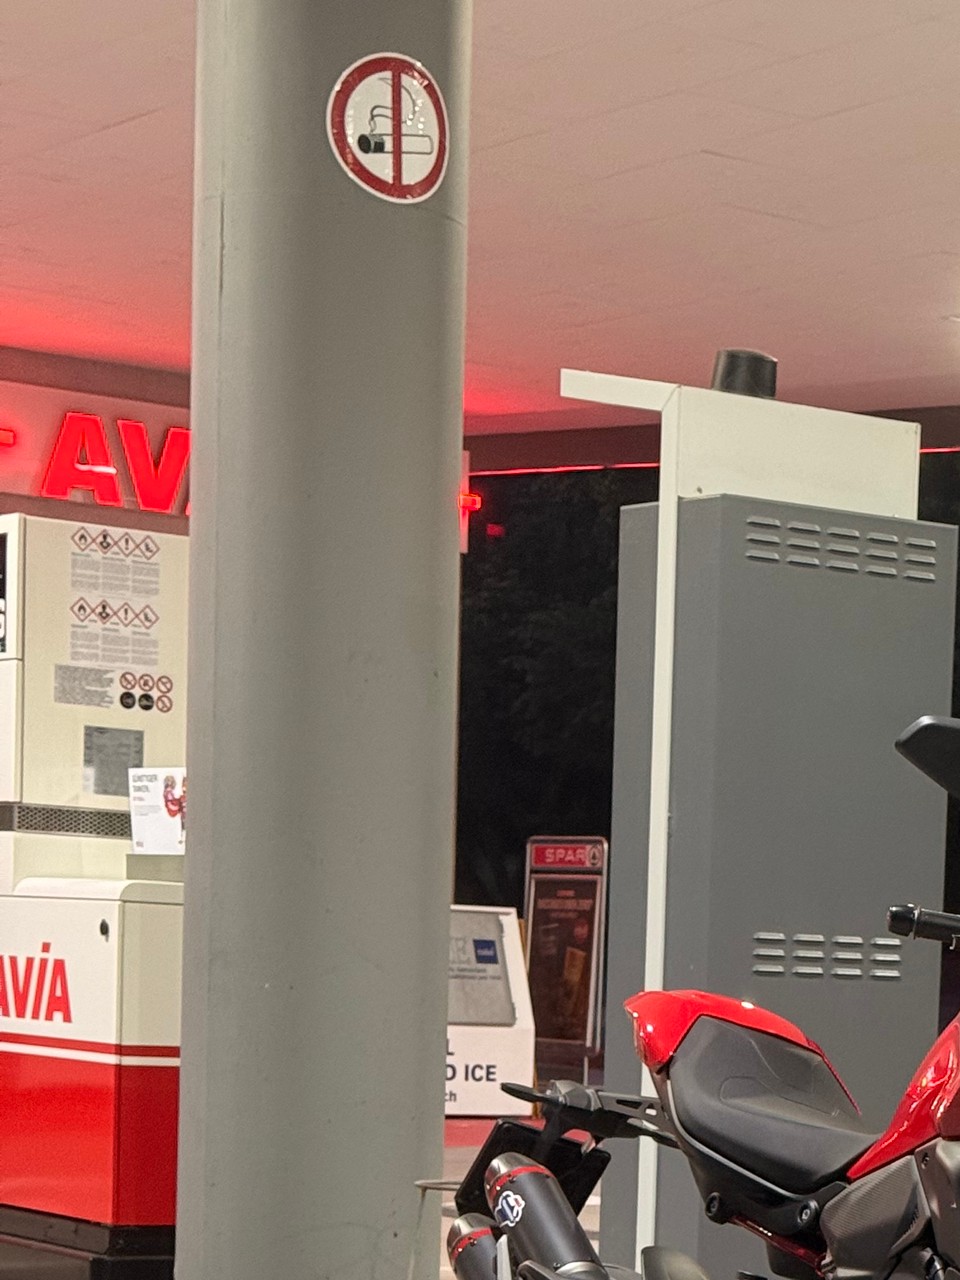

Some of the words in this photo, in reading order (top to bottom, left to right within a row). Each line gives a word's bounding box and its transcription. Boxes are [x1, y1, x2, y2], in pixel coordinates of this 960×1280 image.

[40, 411, 191, 516] AV
[544, 848, 587, 864] SPAR
[464, 1063, 498, 1082] ICE
